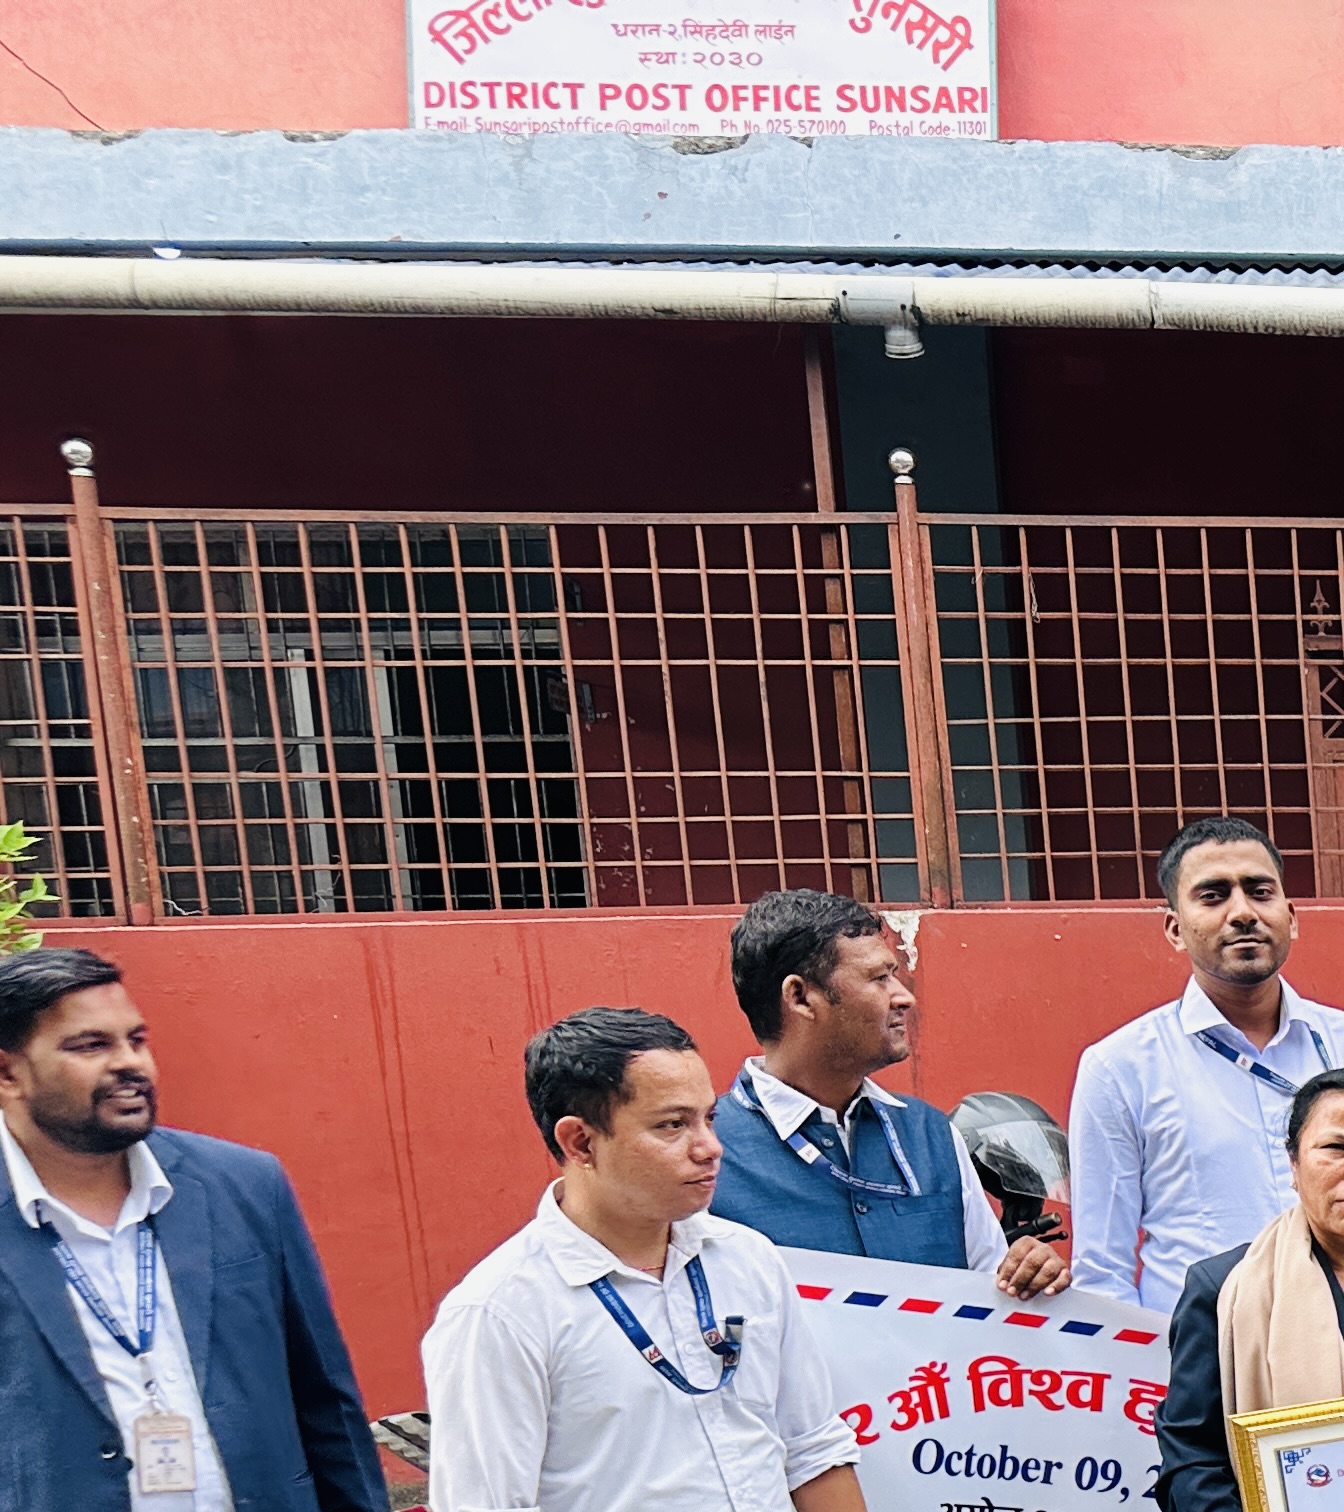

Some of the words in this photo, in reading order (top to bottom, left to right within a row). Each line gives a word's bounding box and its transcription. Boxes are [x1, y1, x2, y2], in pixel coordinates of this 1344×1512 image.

[423, 80, 585, 110] DISTRICT
[599, 83, 693, 112] POST
[705, 84, 821, 113] OFFICE
[836, 84, 988, 114] SUNSARI
[869, 119, 914, 136] Postal
[967, 1355, 1111, 1412] विश्व
[911, 1437, 1063, 1486] October
[1074, 1456, 1130, 1503] 09,
